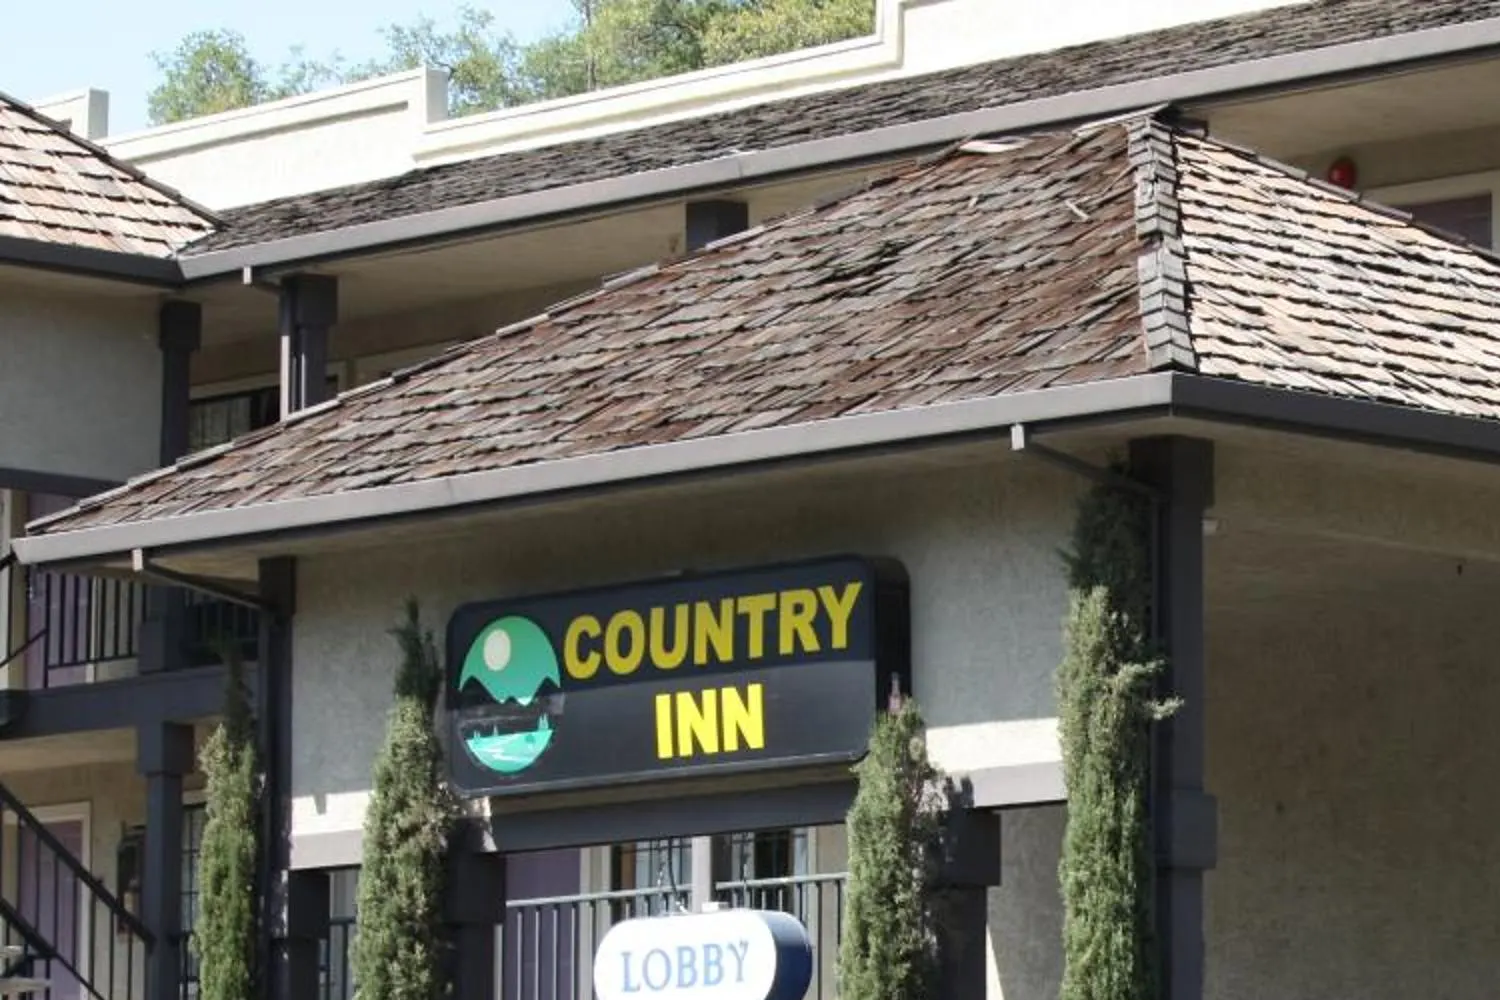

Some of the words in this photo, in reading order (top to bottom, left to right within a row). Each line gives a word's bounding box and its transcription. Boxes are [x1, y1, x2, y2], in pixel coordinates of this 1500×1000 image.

[563, 582, 863, 680] COUNTRY
[655, 683, 765, 760] INN
[620, 938, 750, 993] LOBBY
